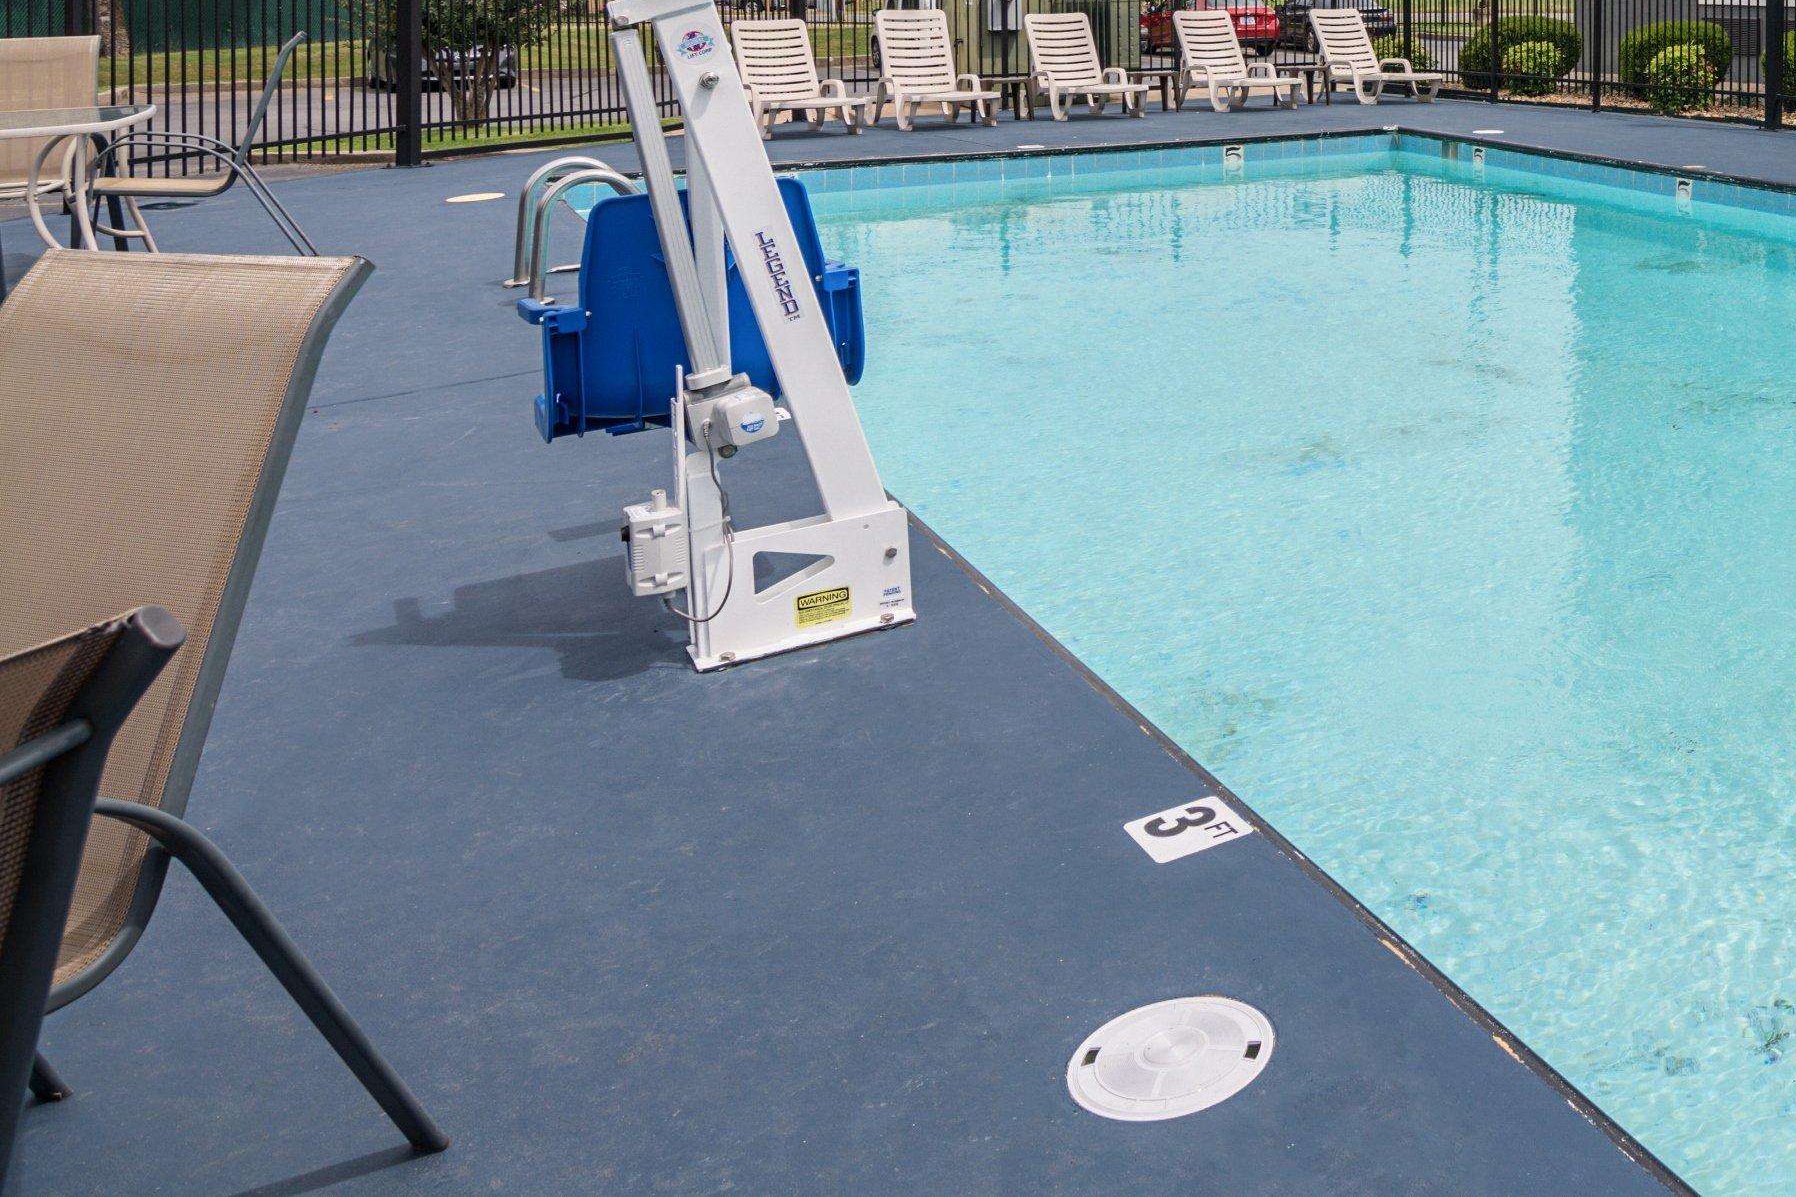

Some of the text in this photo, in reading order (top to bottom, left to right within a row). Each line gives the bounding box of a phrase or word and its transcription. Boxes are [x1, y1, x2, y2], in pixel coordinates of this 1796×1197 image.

[1225, 146, 1242, 162] 5
[1473, 147, 1483, 162] 5
[1677, 180, 1691, 196] 5
[800, 590, 847, 607] WARNING
[1143, 806, 1239, 839] 3 FT
